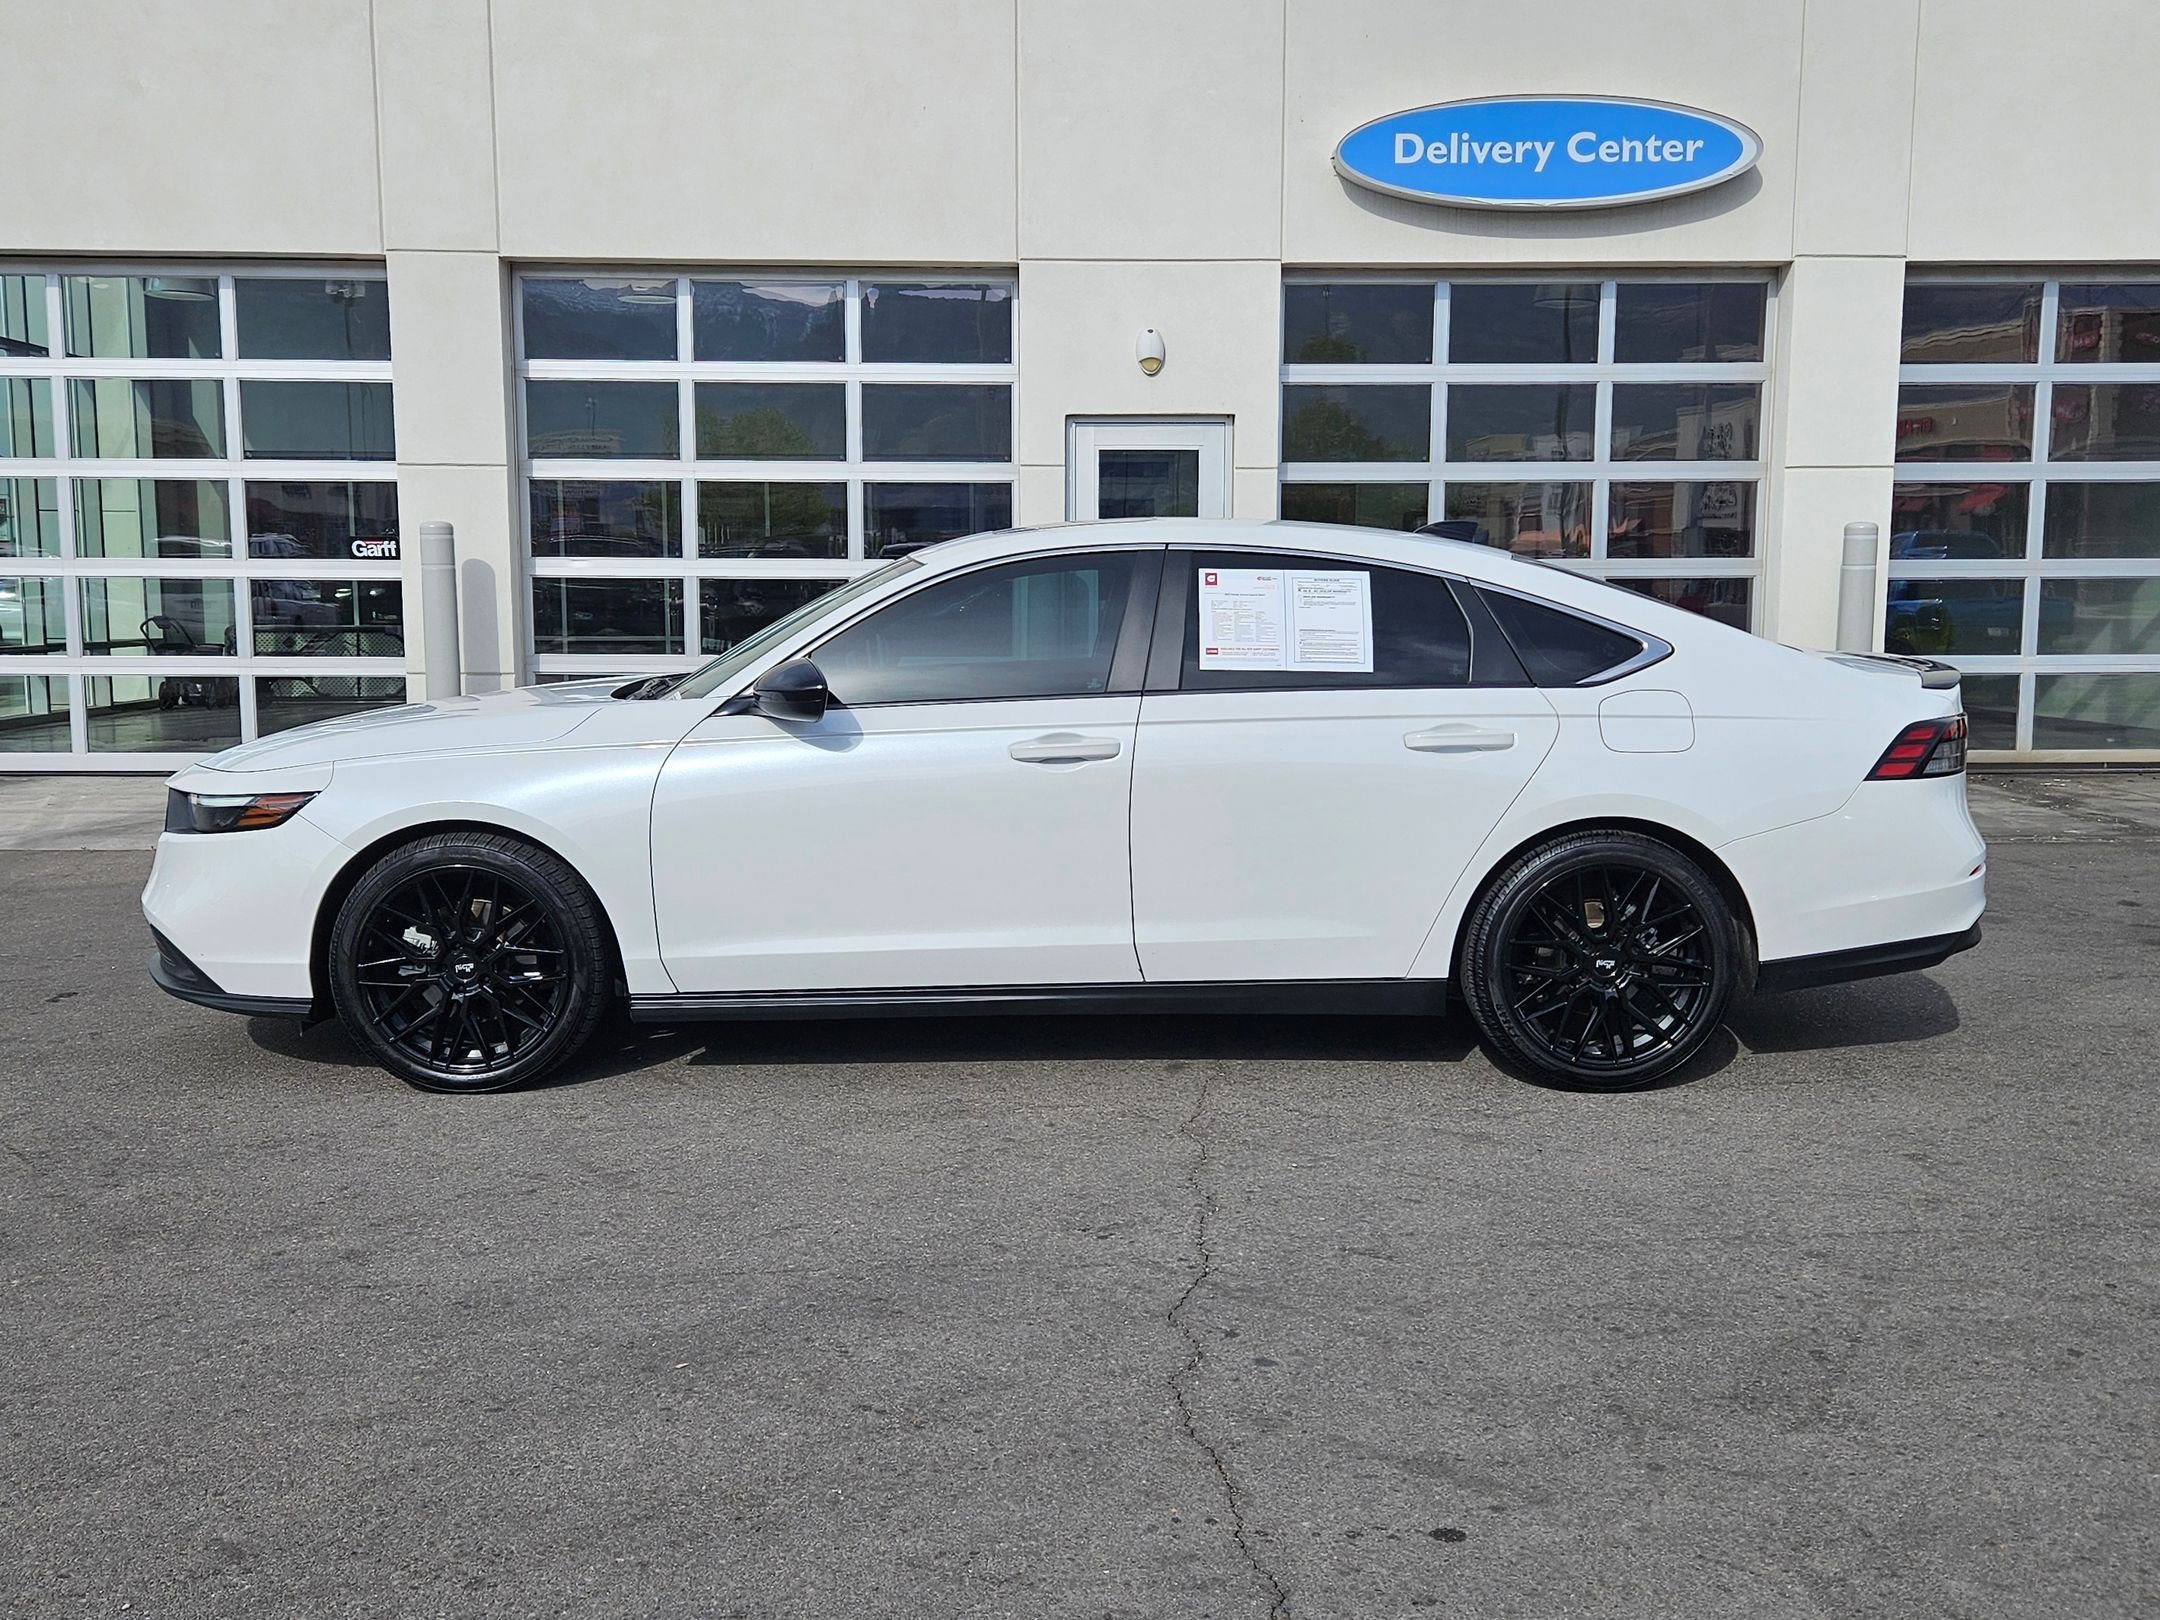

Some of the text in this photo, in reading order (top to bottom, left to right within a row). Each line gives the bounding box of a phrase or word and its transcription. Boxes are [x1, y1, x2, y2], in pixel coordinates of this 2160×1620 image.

[1394, 131, 1705, 173] Delivery Center
[351, 540, 397, 557] Garff
